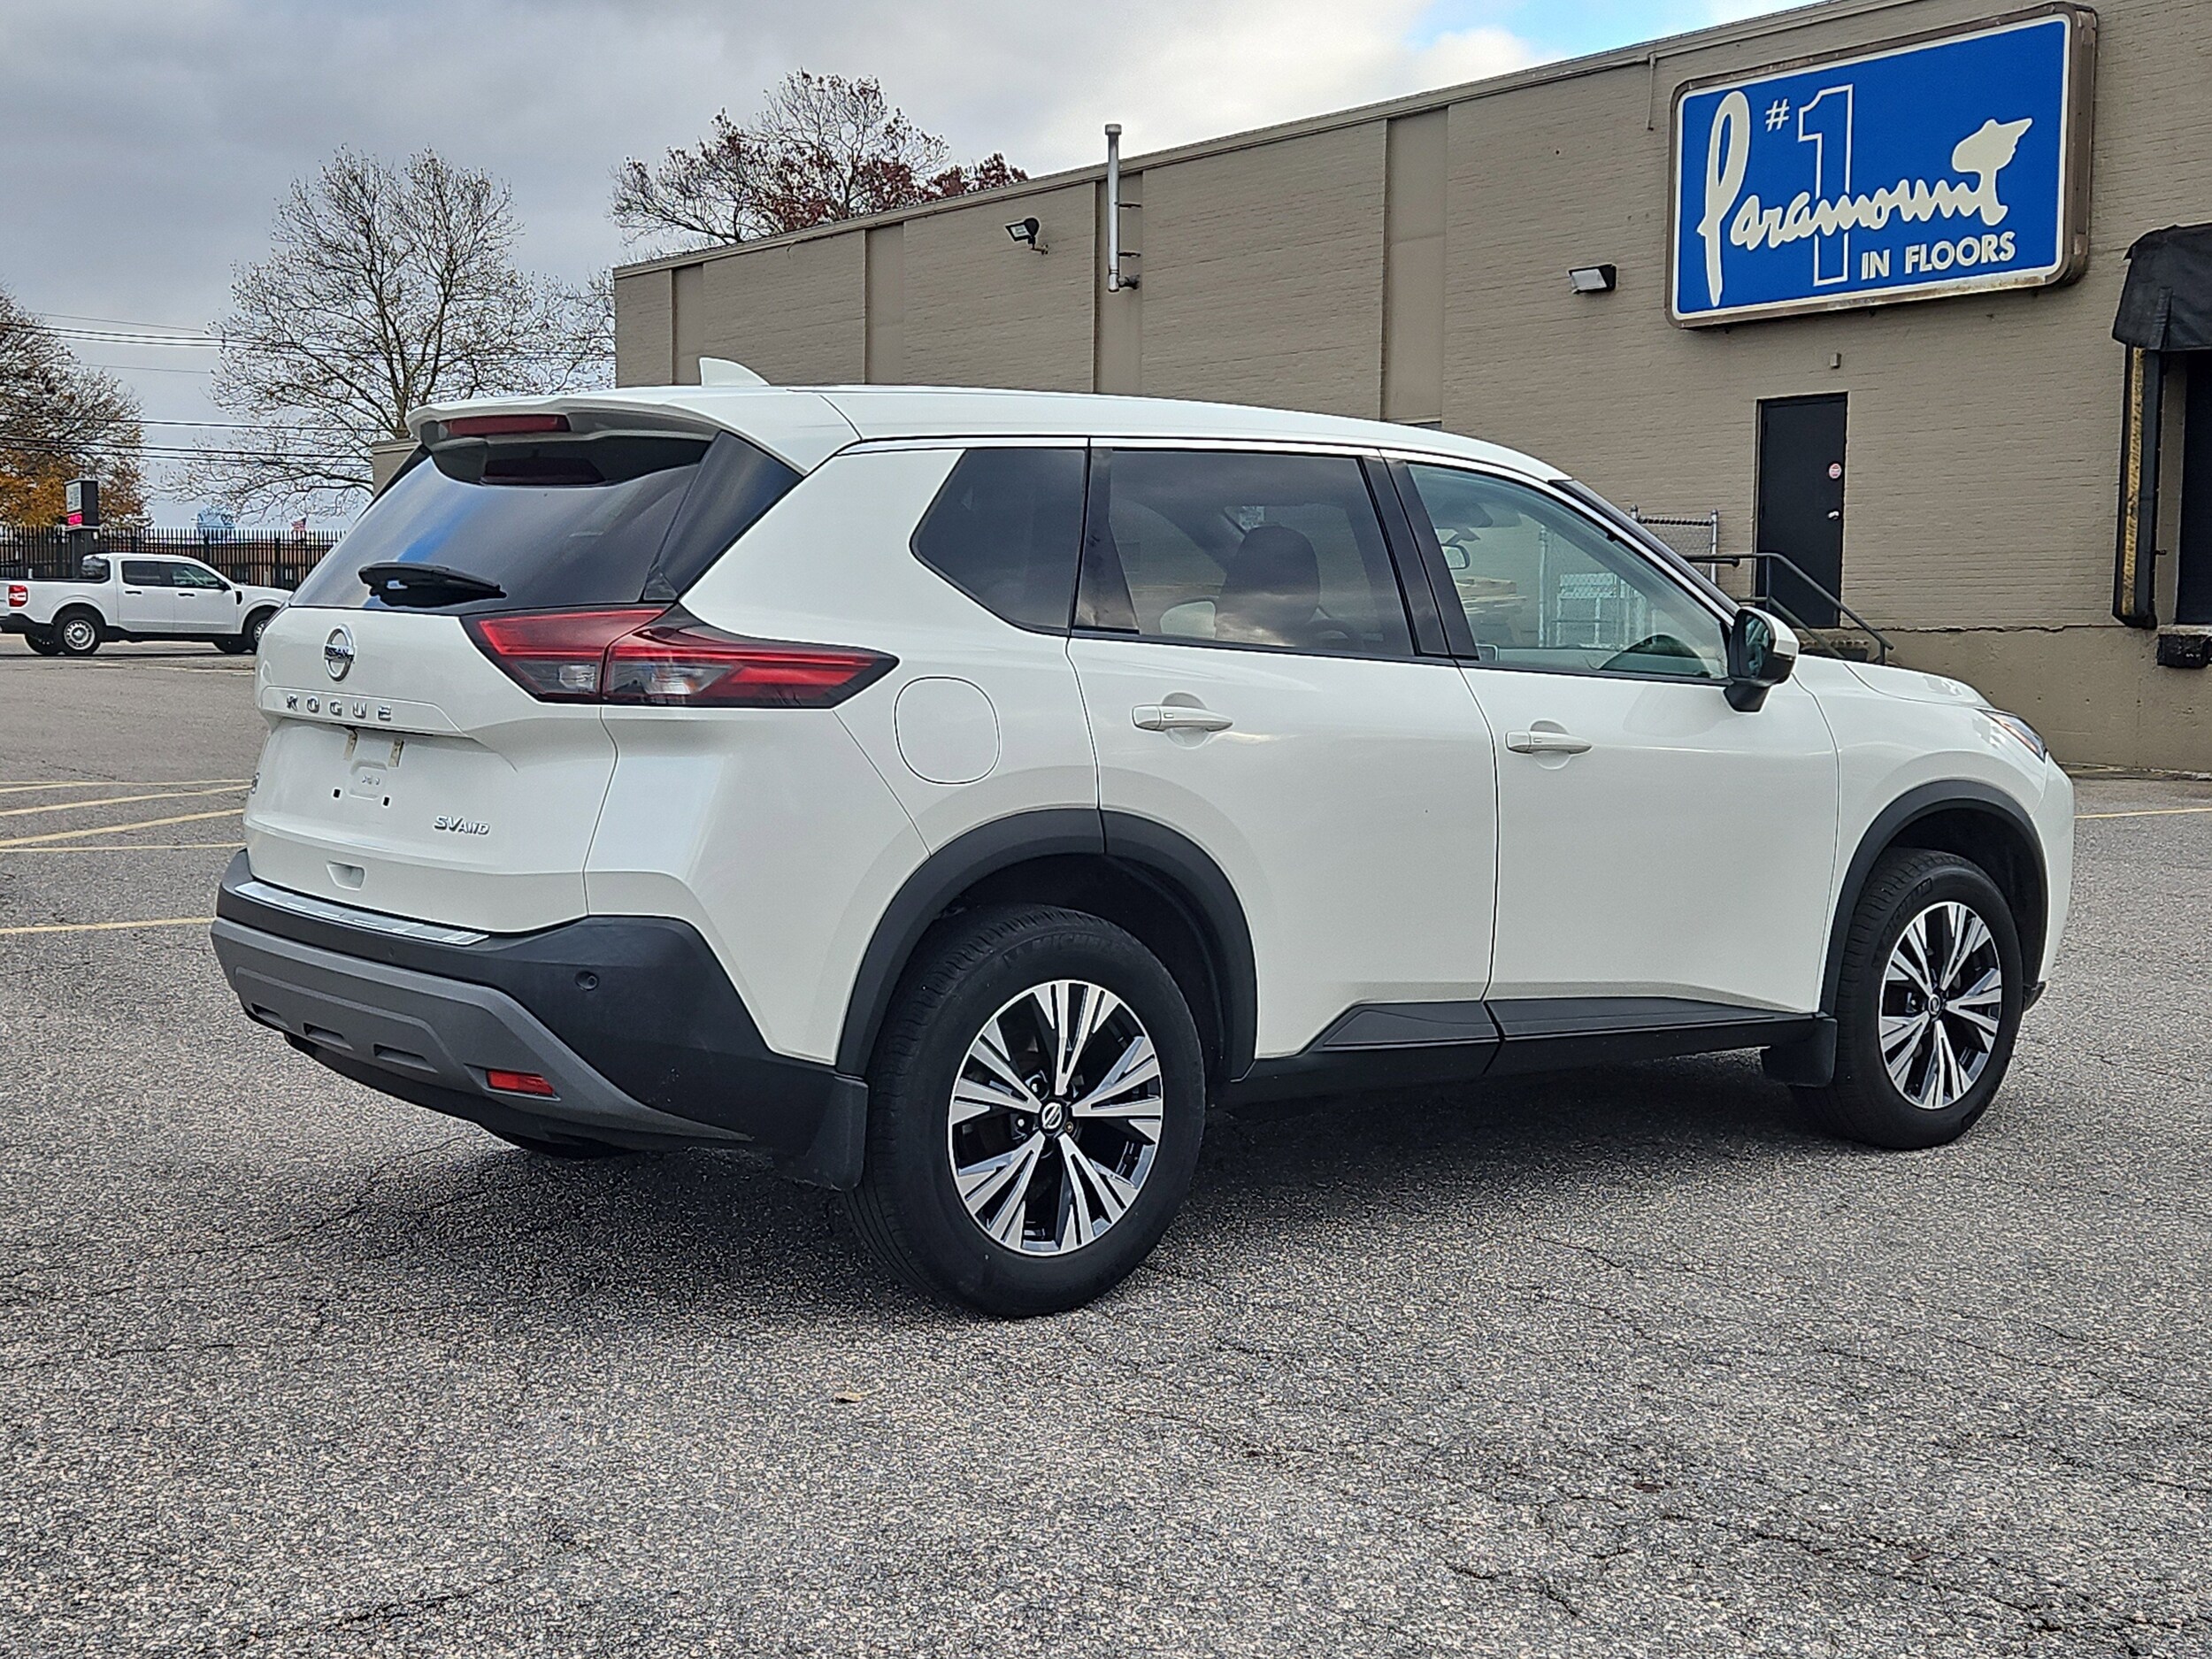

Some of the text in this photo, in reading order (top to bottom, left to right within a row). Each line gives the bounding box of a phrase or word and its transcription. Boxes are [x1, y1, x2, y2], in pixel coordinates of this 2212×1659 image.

[1696, 90, 2033, 308] Paramount
[1861, 231, 2016, 280] IN FLOORS
[286, 694, 392, 722] ROGUE
